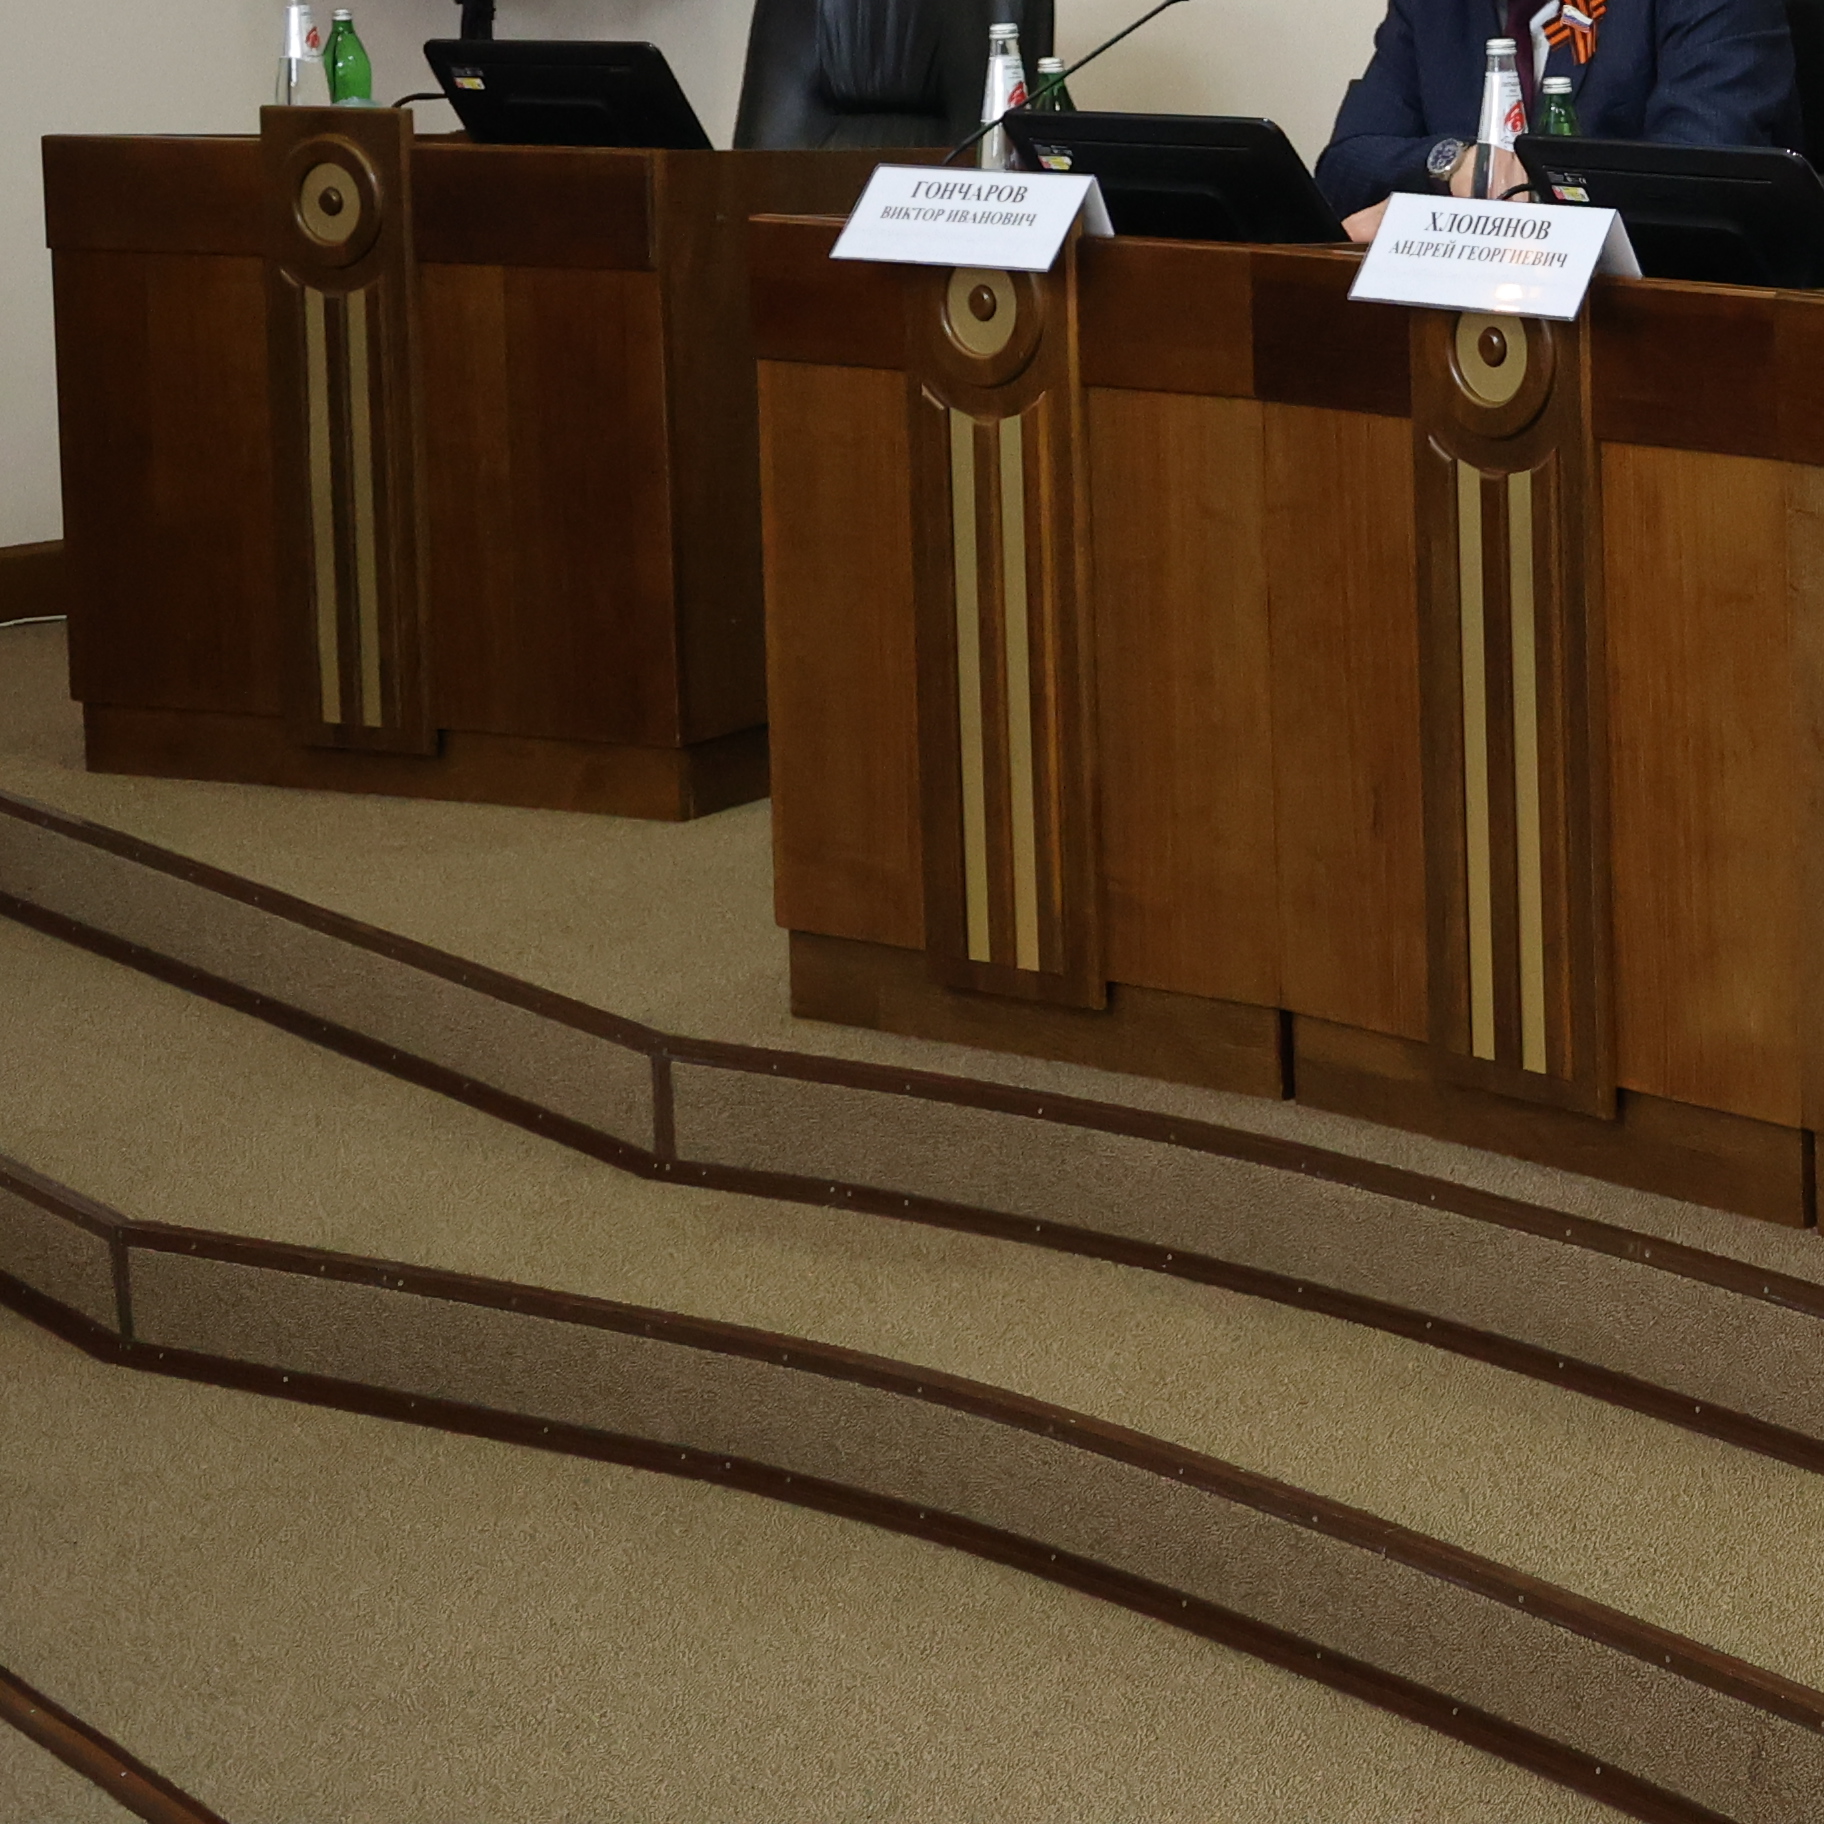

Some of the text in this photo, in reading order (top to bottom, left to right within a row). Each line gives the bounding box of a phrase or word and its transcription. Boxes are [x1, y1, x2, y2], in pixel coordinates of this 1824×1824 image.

[911, 180, 1028, 204] ГОНЧАРОВ
[879, 205, 1038, 227] ВИКТОР ИВАНОВИЧ
[1424, 211, 1552, 240] ХЛОПЯНОВ
[1388, 239, 1569, 268] АНДРЕЙ ГЕОРГИЕВИЧ
